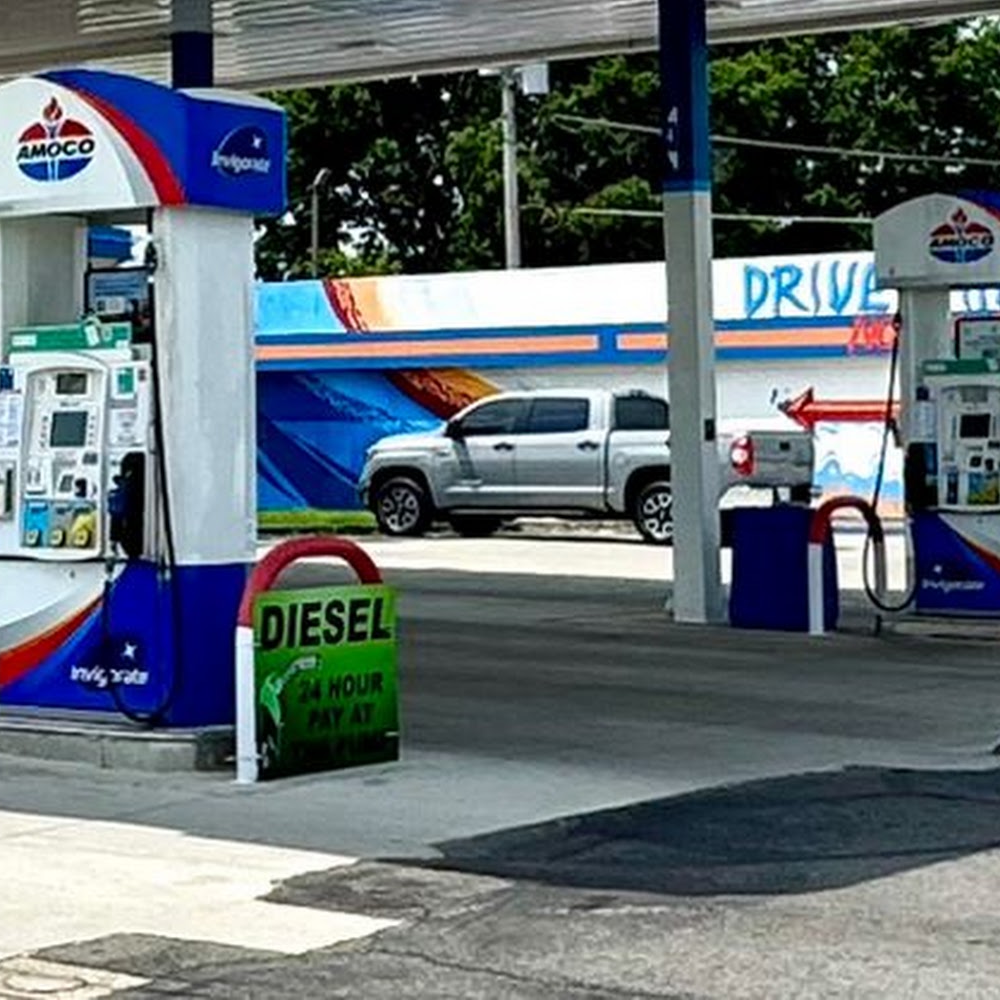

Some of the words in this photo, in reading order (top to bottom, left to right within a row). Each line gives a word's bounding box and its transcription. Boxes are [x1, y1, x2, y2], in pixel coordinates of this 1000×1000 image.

[15, 139, 96, 162] AMOCO
[743, 261, 890, 319] DRIVE
[260, 597, 392, 650] DIESEL
[70, 665, 149, 688] Invigrate
[329, 672, 384, 700] HOUR
